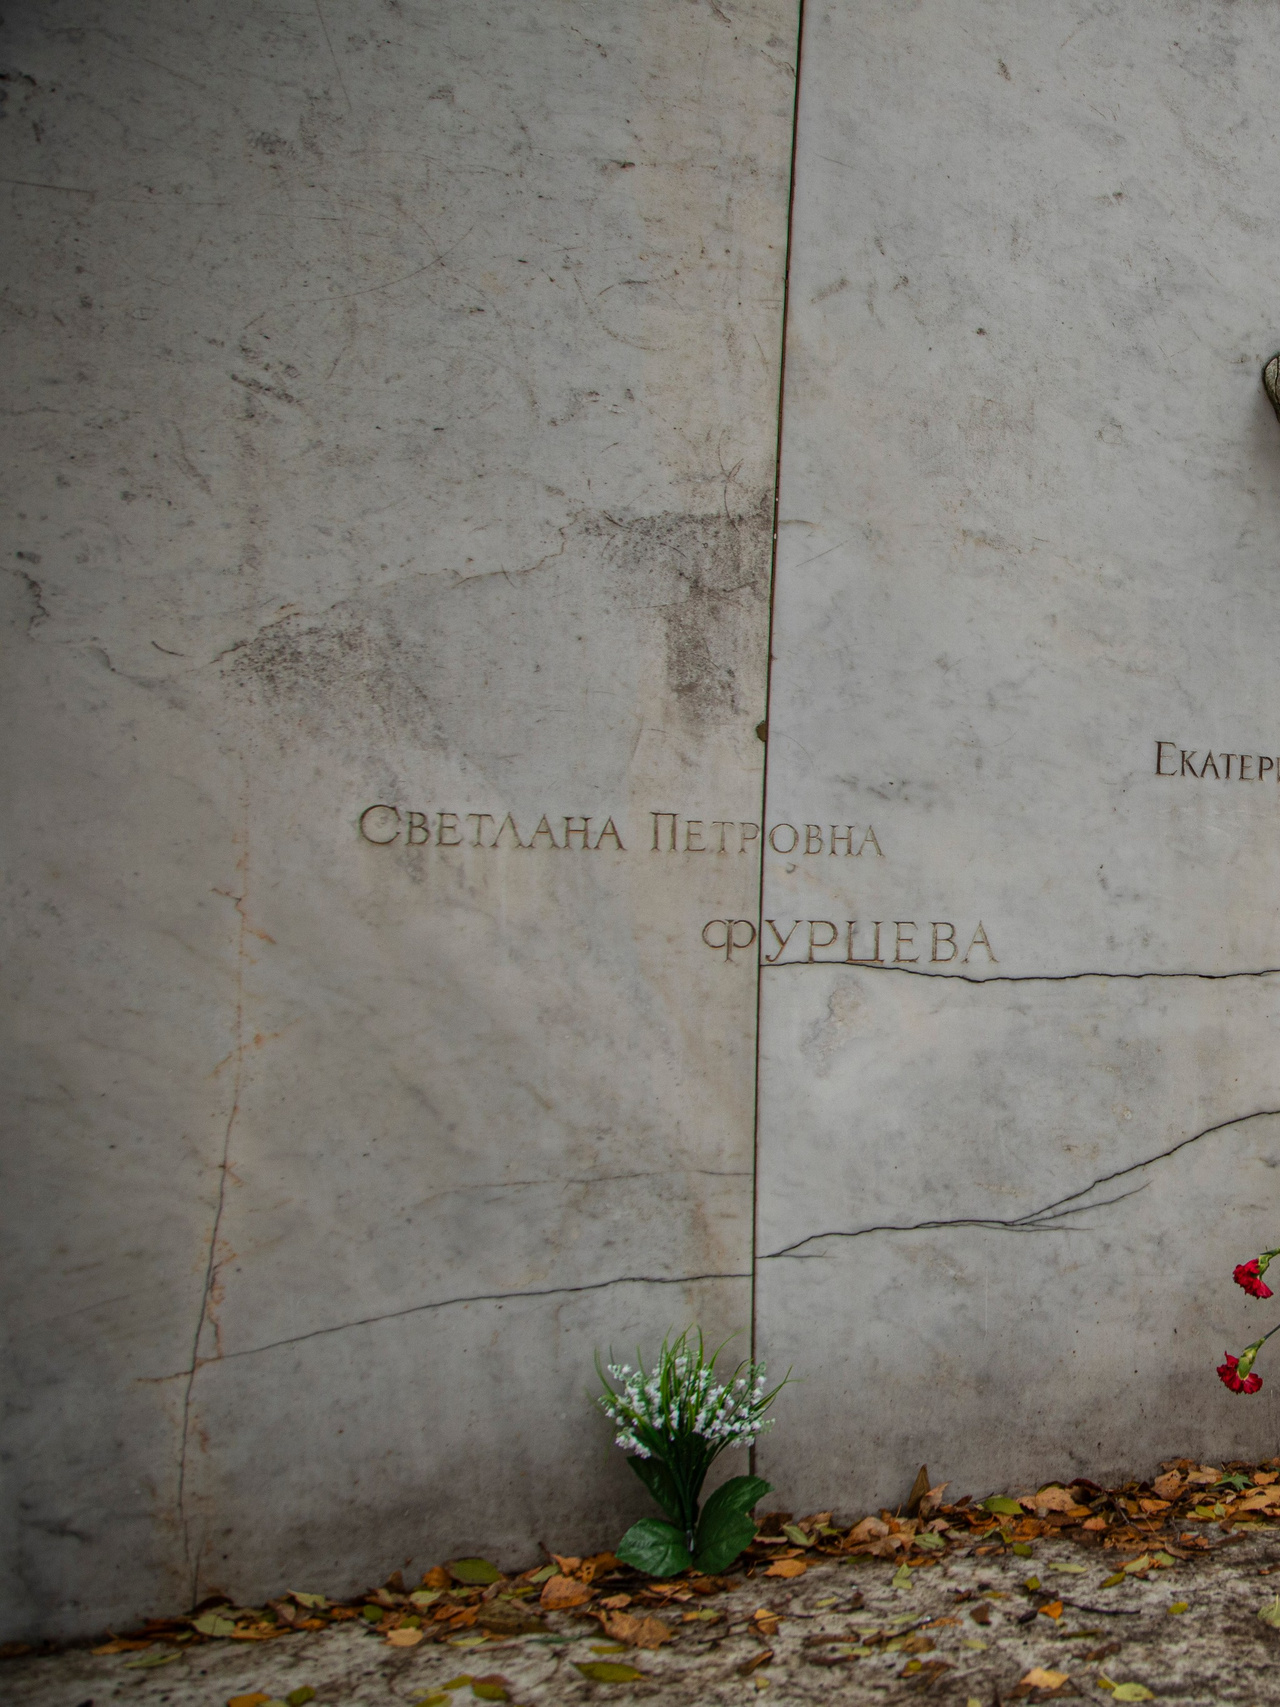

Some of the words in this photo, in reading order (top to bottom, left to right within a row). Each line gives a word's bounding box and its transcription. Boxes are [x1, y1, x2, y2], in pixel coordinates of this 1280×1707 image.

[358, 804, 628, 851] СВЕТЛАНА
[649, 811, 886, 857] ПЕТРОВНА
[701, 919, 999, 964] ФУРЦЕВА
